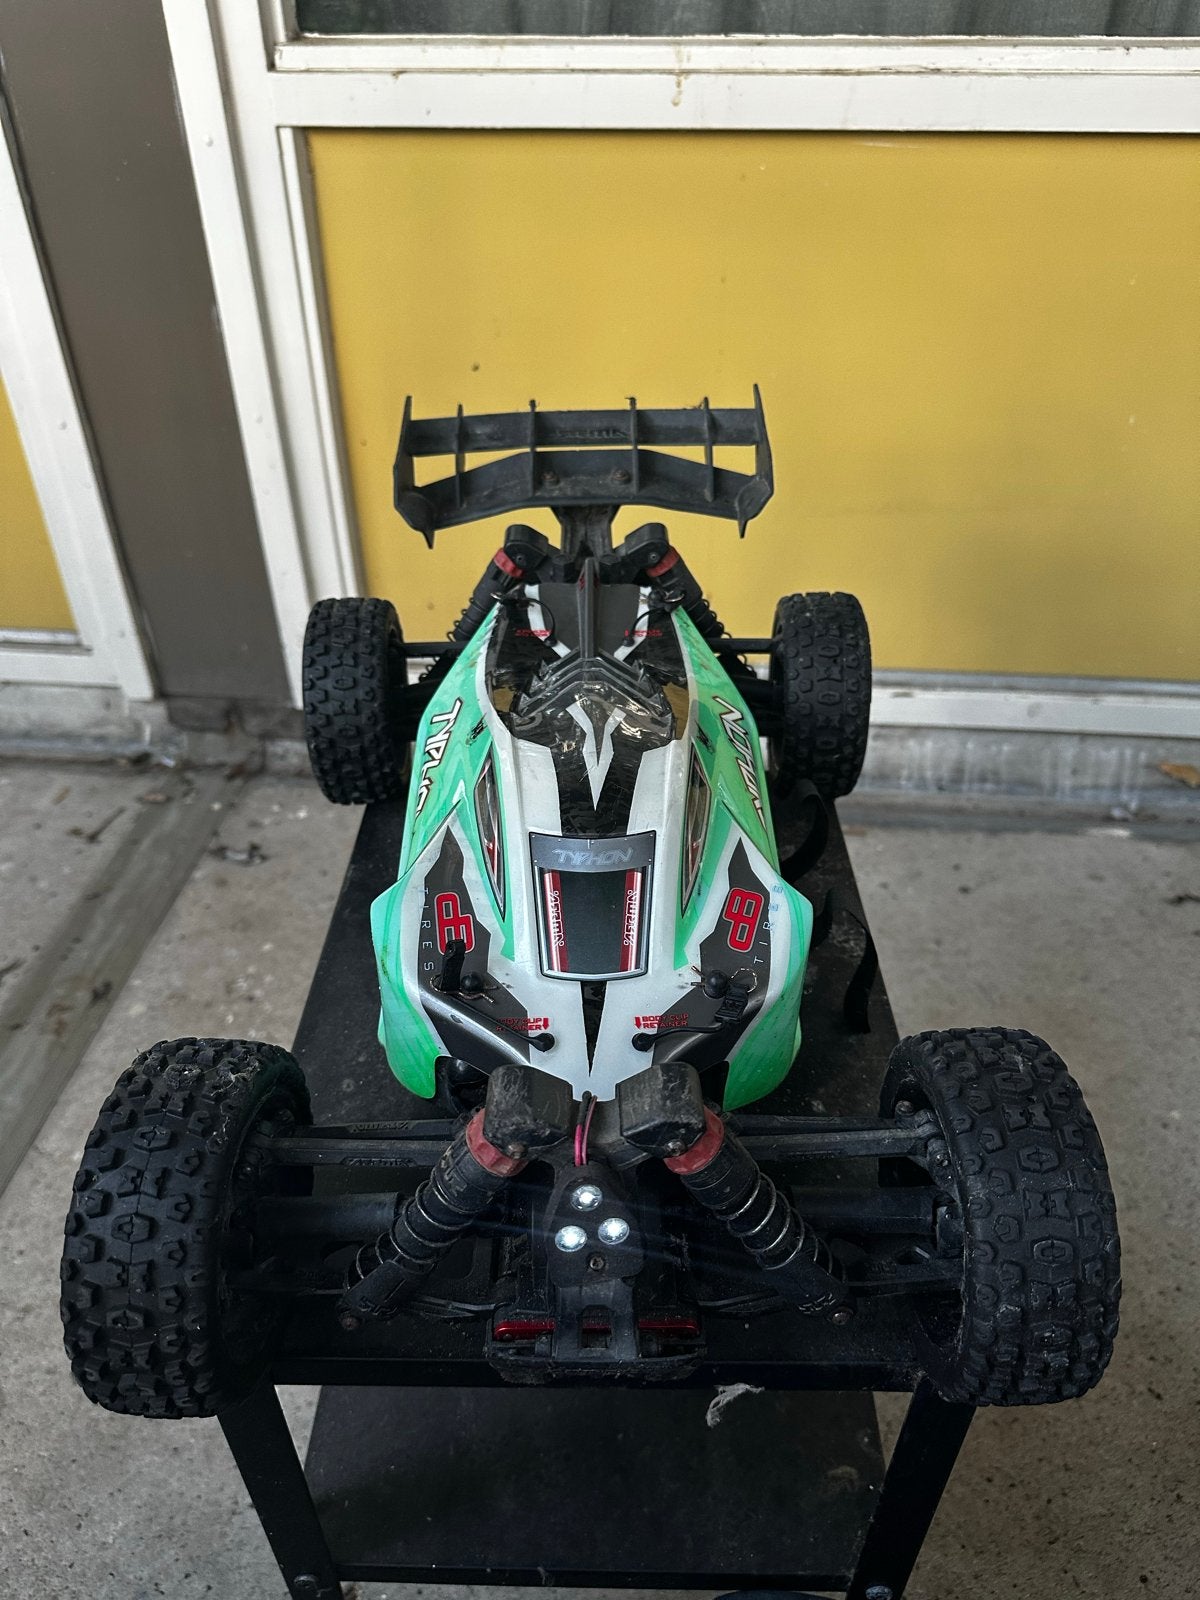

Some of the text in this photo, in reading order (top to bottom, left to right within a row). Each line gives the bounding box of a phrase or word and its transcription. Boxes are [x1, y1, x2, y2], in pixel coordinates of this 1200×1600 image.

[415, 697, 463, 818] TYPHO
[551, 847, 635, 866] TYPHON
[417, 887, 434, 971] TIRES
[753, 885, 784, 964] TIRES
[642, 1020, 688, 1029] RETAINER
